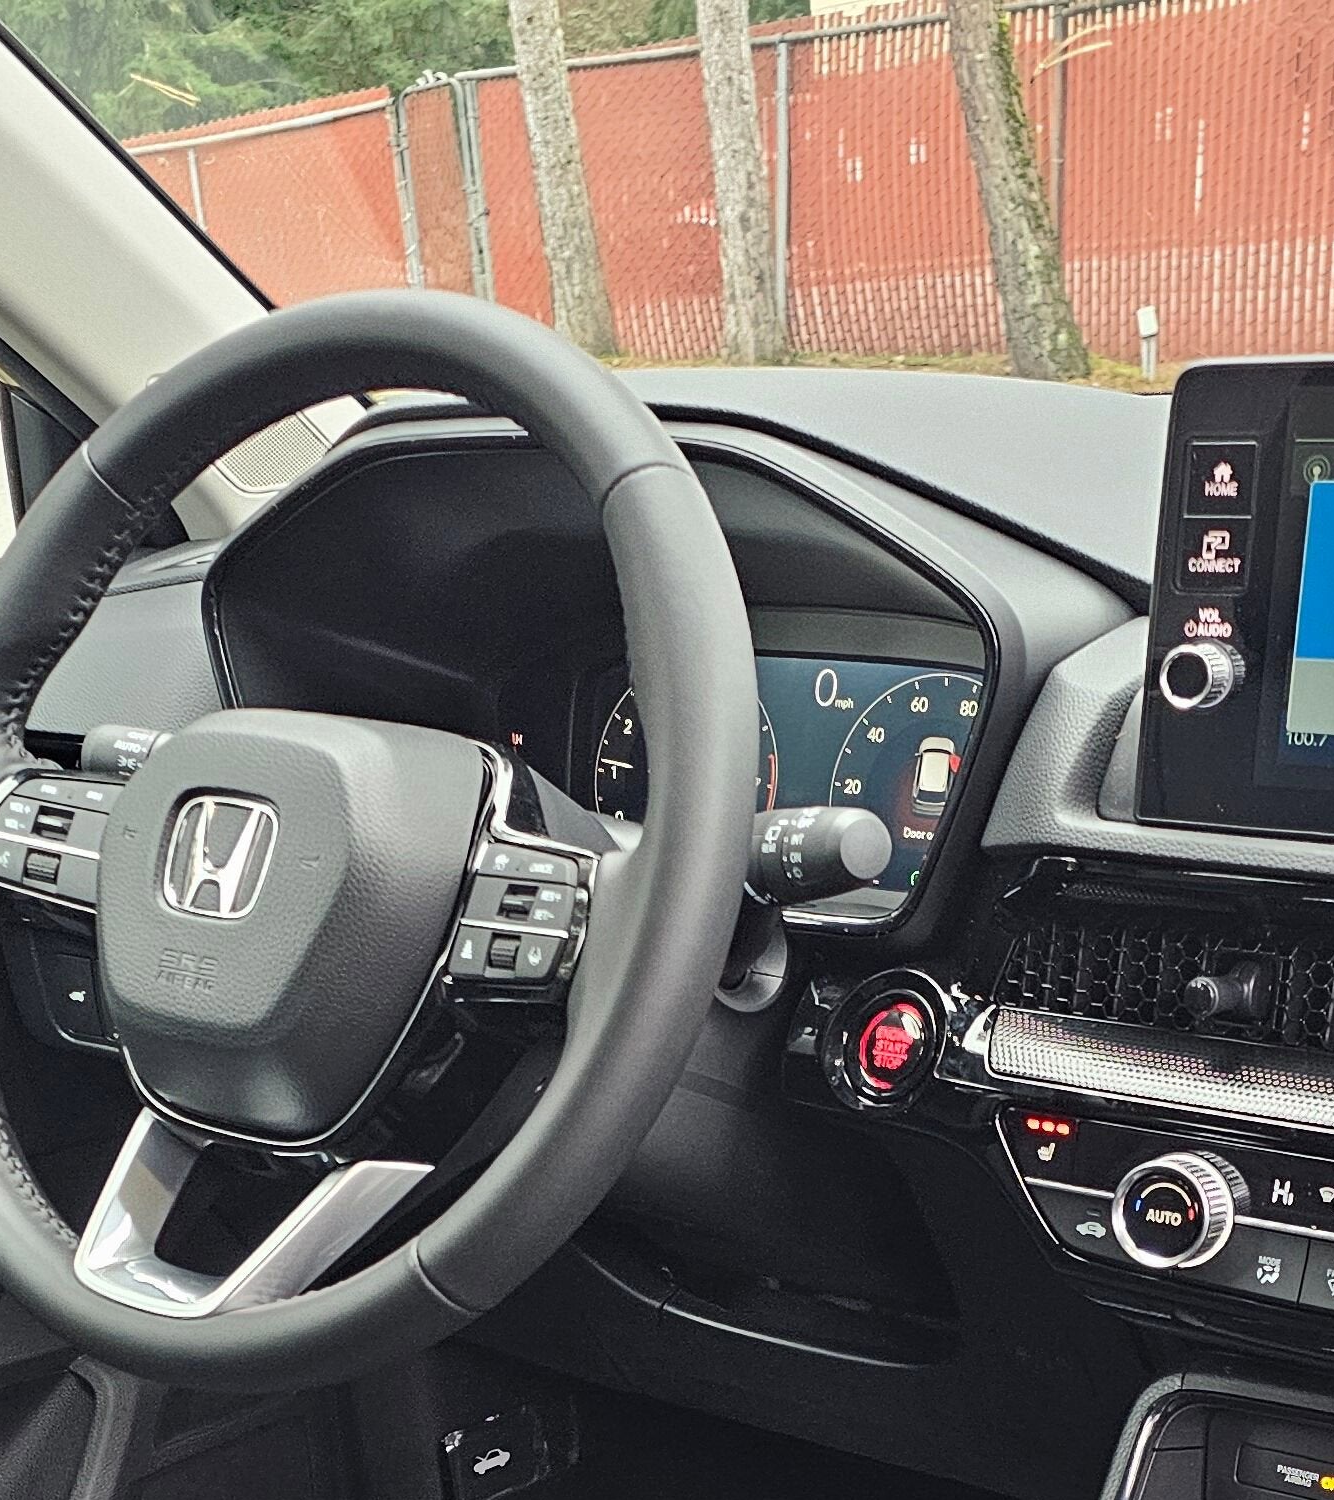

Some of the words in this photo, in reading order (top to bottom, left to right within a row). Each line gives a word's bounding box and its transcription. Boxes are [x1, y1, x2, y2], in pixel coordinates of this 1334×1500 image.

[1204, 481, 1239, 497] HOME
[1188, 557, 1241, 574] CONNECT
[1199, 608, 1221, 623] VOL
[1197, 623, 1233, 638] AUDIO
[815, 669, 838, 707] 0
[835, 698, 854, 711] mph
[910, 696, 929, 713] 60
[960, 700, 979, 717] 80
[623, 719, 633, 735] 2
[867, 727, 885, 744] 40
[1286, 731, 1328, 748] 100.7
[611, 765, 617, 780] 1
[843, 778, 862, 795] 20
[160, 947, 219, 972] SRS
[874, 1039, 910, 1055] START
[1145, 1208, 1183, 1227] AUTO
[1258, 1255, 1282, 1267] MODE
[1276, 1464, 1320, 1482] PASSENGER
